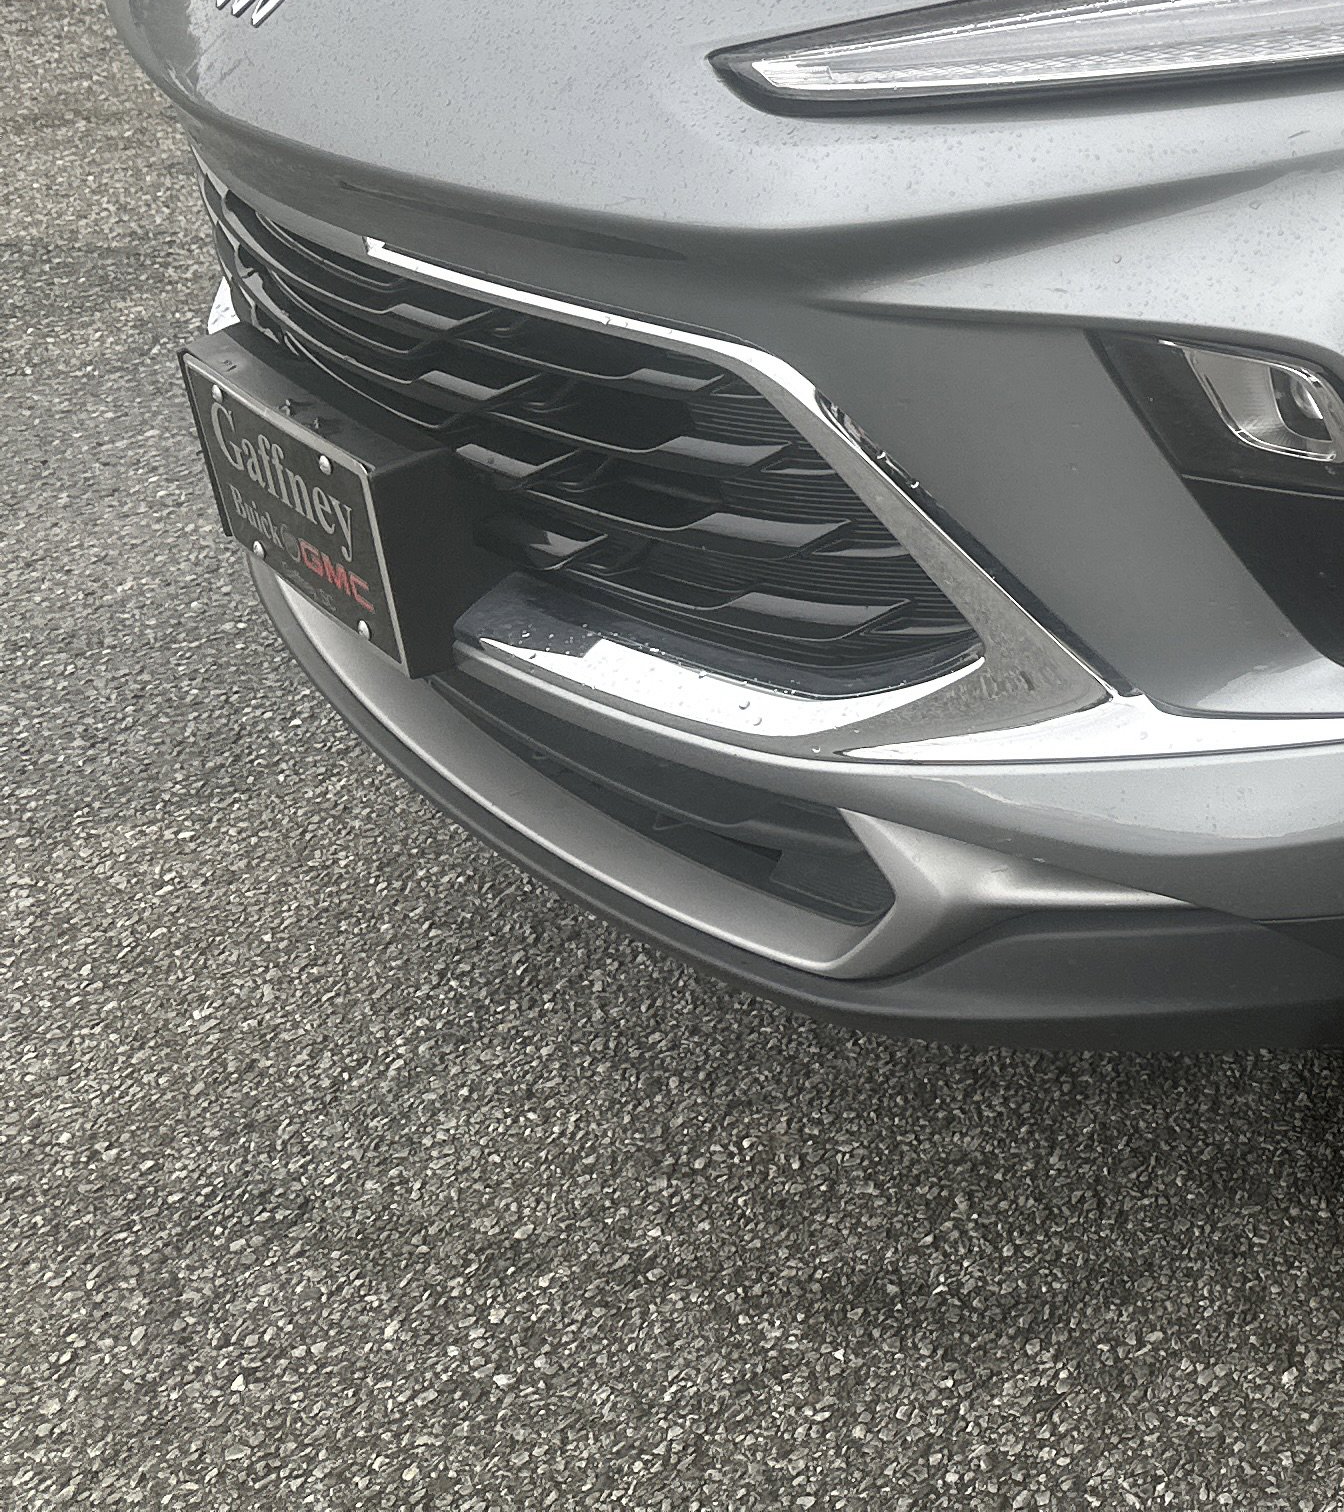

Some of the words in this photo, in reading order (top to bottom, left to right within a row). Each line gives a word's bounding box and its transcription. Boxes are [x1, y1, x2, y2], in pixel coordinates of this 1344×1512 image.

[211, 401, 354, 563] Gaffney
[228, 482, 284, 548] Buick
[299, 537, 376, 614] GMC
